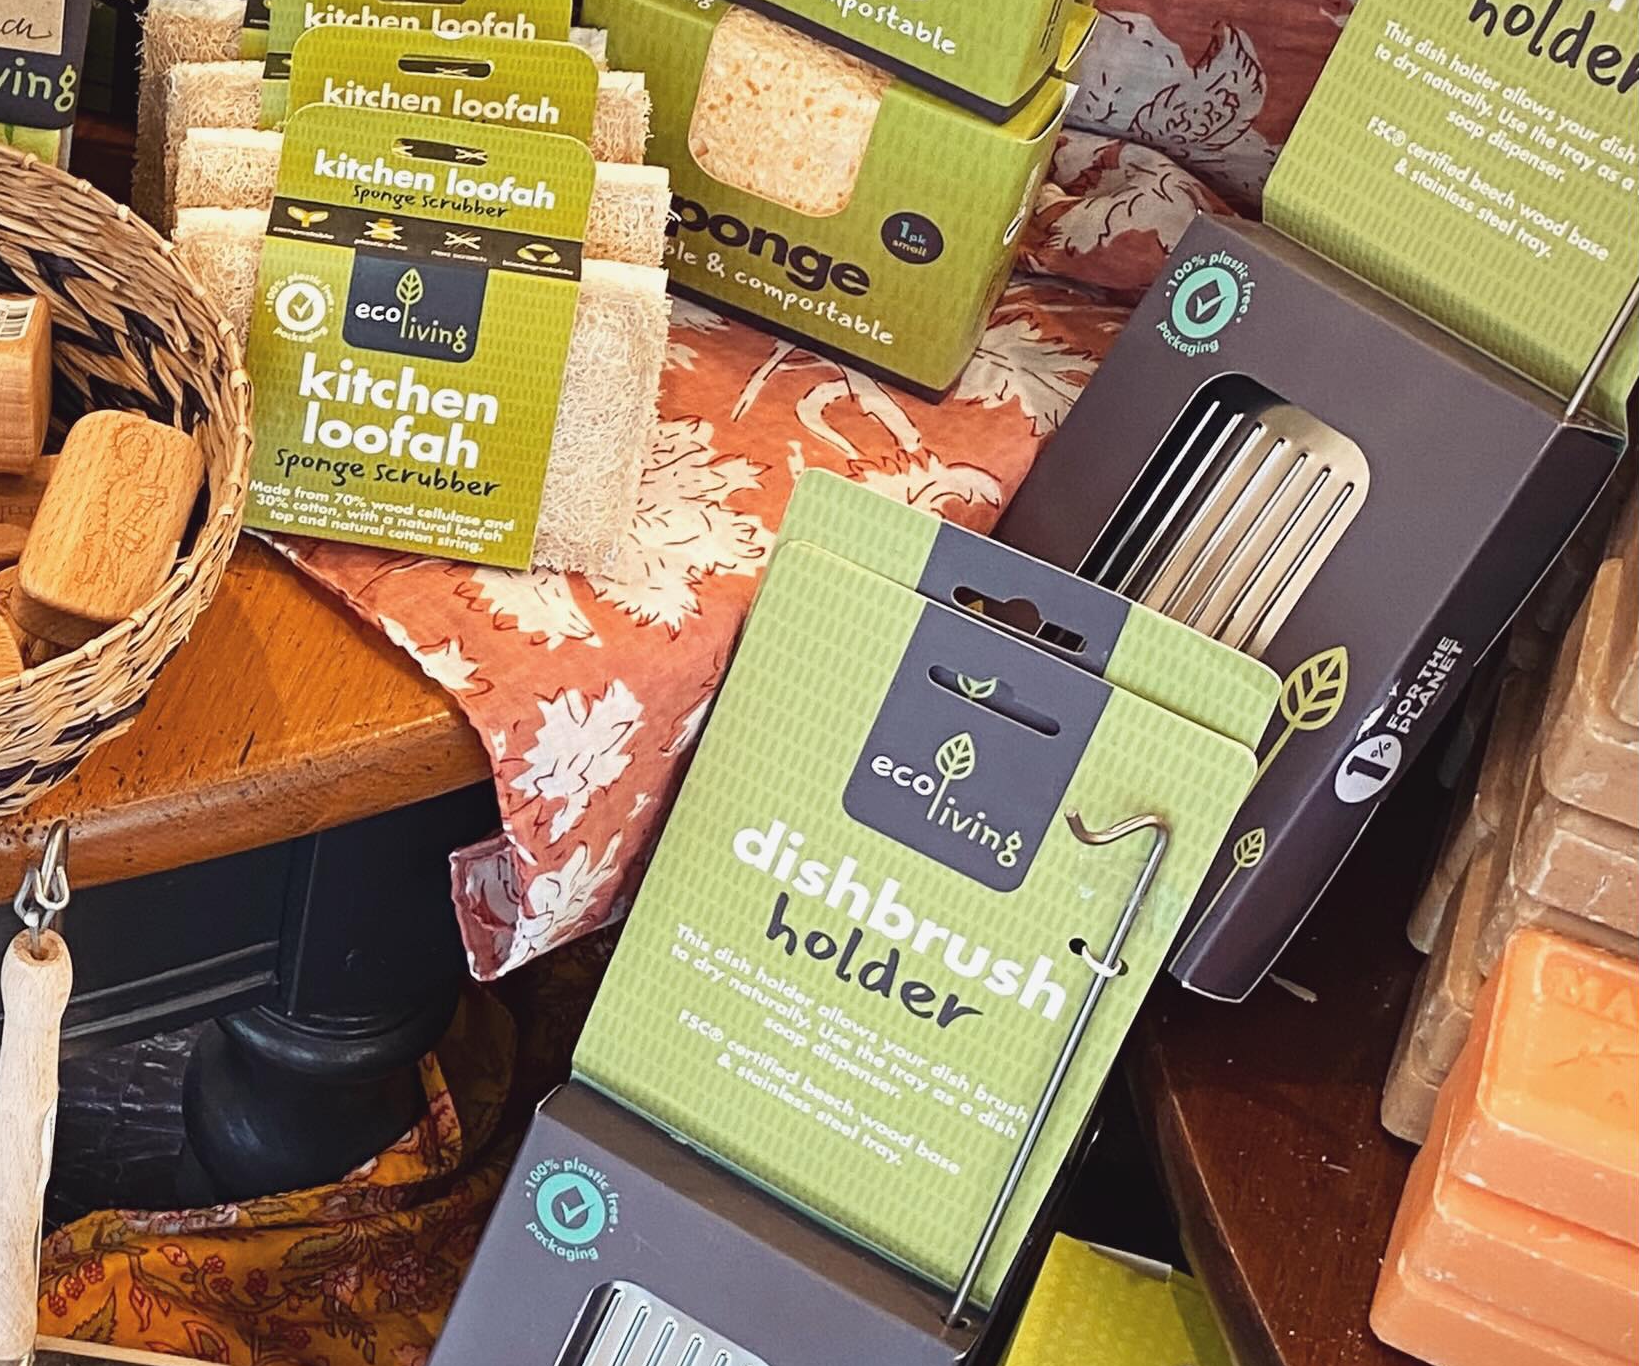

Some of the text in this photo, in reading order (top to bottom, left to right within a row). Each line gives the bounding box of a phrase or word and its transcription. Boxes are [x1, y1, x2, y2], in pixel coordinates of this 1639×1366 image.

[1382, 19, 1638, 168] This dish holder allows your dish
[313, 148, 557, 210] kitchen loofah
[1445, 108, 1567, 183] soap dispenser.
[352, 184, 510, 220] sponge scrubber
[1406, 139, 1471, 188] certified
[1470, 170, 1517, 211] beech
[1518, 195, 1568, 240] wood
[1567, 221, 1610, 263] base
[705, 252, 895, 346] & compostable
[1166, 254, 1206, 288] 100%
[1208, 250, 1249, 281] plastic
[1156, 320, 1220, 357] packaging
[298, 351, 500, 425] kitchen
[275, 447, 501, 497] sponge scrubber
[301, 401, 481, 470] loofah
[1386, 635, 1454, 731] FOR THE
[1397, 638, 1464, 735] PLANET
[870, 753, 1024, 869] eco living
[732, 819, 1069, 1023] dishbrush
[764, 890, 985, 1030] holder
